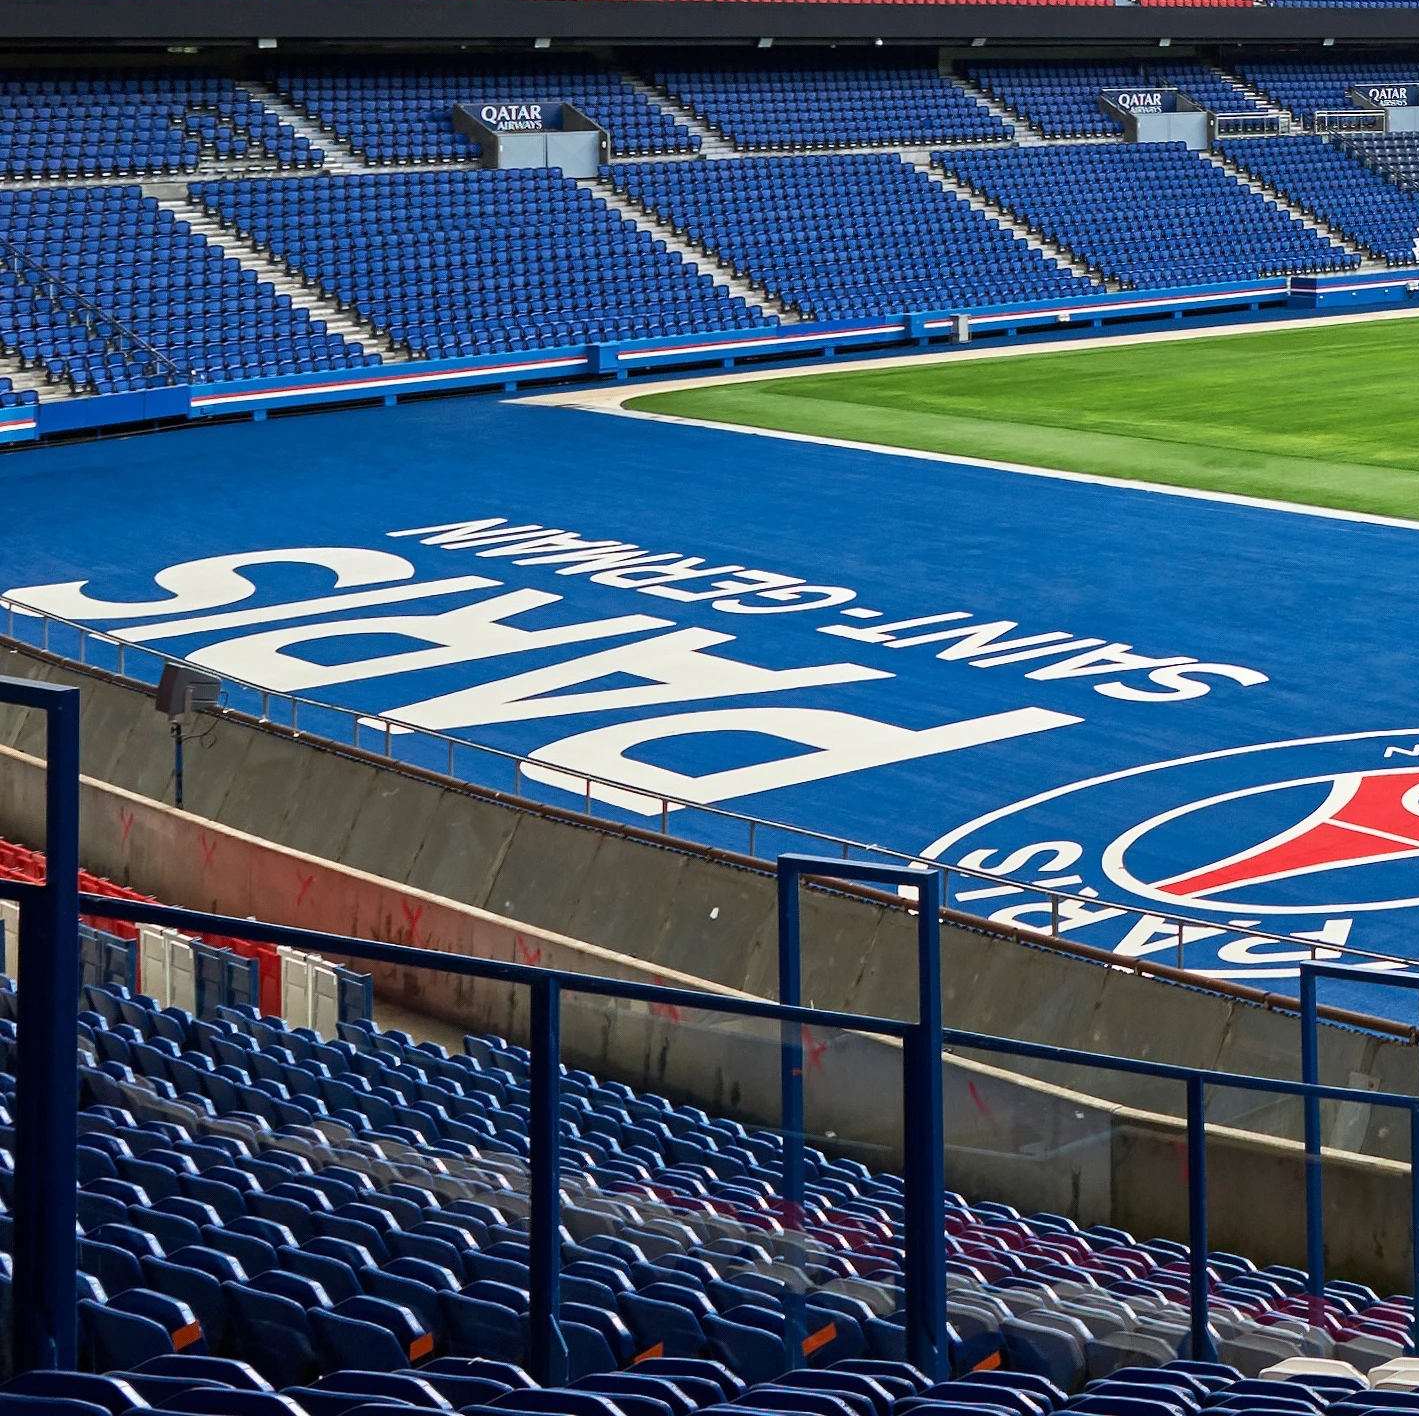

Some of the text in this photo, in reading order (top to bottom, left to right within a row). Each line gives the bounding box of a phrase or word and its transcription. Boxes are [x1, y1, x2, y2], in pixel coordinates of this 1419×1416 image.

[1118, 93, 1161, 109] QATAR
[1369, 87, 1407, 101] QATAR
[480, 104, 542, 124] QATAR
[497, 120, 543, 131] AIRWAYS
[386, 518, 1271, 702] SAINT-GERMAIN
[1, 546, 1086, 816] PARIS
[955, 840, 1354, 965] PARIS
